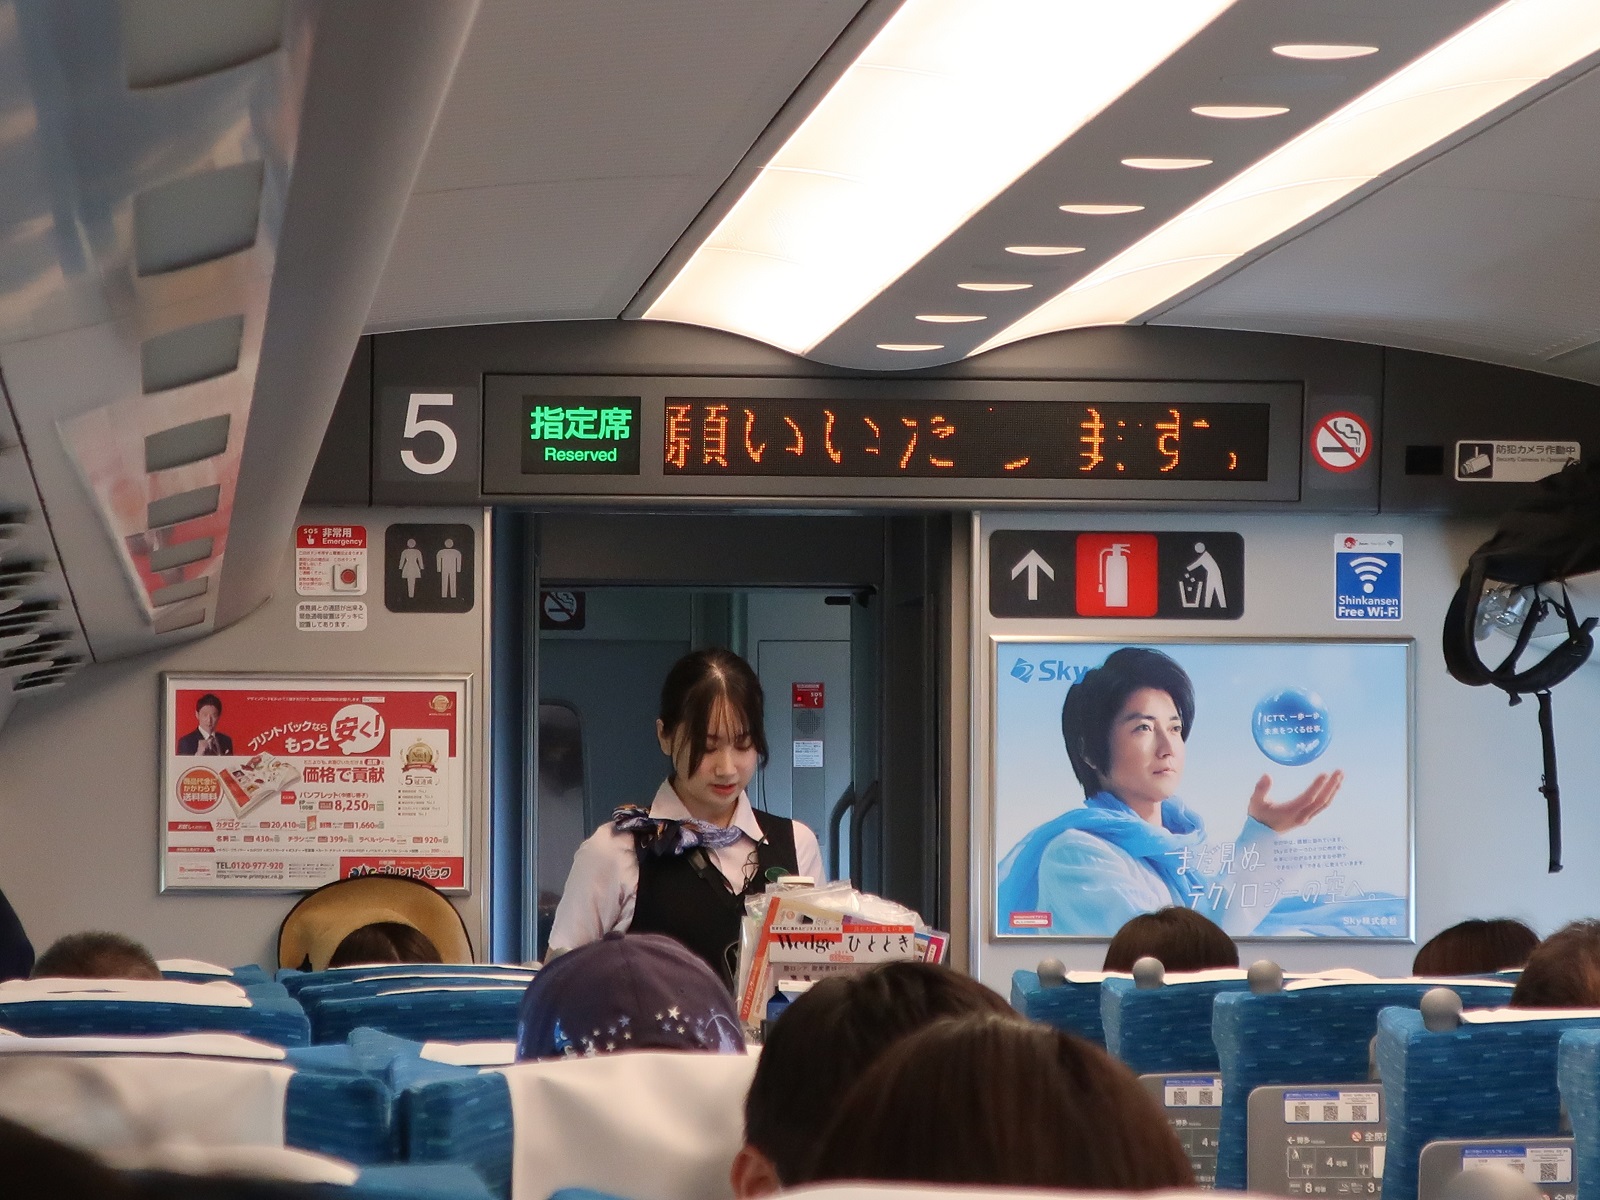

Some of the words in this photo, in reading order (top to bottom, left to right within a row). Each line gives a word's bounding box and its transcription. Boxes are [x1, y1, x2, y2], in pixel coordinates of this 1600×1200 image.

[529, 405, 633, 441] 指定席
[400, 393, 457, 475] 5
[543, 447, 619, 463] Reserved
[1496, 444, 1576, 455] 防犯カメラ作動中
[322, 527, 353, 538] 非常用
[322, 538, 364, 546] Emergency
[1338, 595, 1399, 605] Shinkansen
[1338, 607, 1365, 617] Free
[1367, 606, 1399, 617] Wi-Fi
[1038, 660, 1089, 685] Sky
[247, 720, 329, 752] プリントパックなら
[1264, 725, 1324, 736] 未来をつくる仕事。
[285, 734, 331, 753] もっと
[302, 766, 385, 783] 価格で貢献
[183, 792, 217, 802] 送料無料
[335, 799, 376, 812] 8,250円
[215, 821, 241, 829] カタログ
[1163, 842, 1266, 875] まだ見ぬ
[1187, 869, 1377, 911] テクノロジーの空へ。
[1343, 916, 1398, 926] Sky株式会社
[777, 933, 835, 954] Wedge
[848, 934, 909, 953] ひととき
